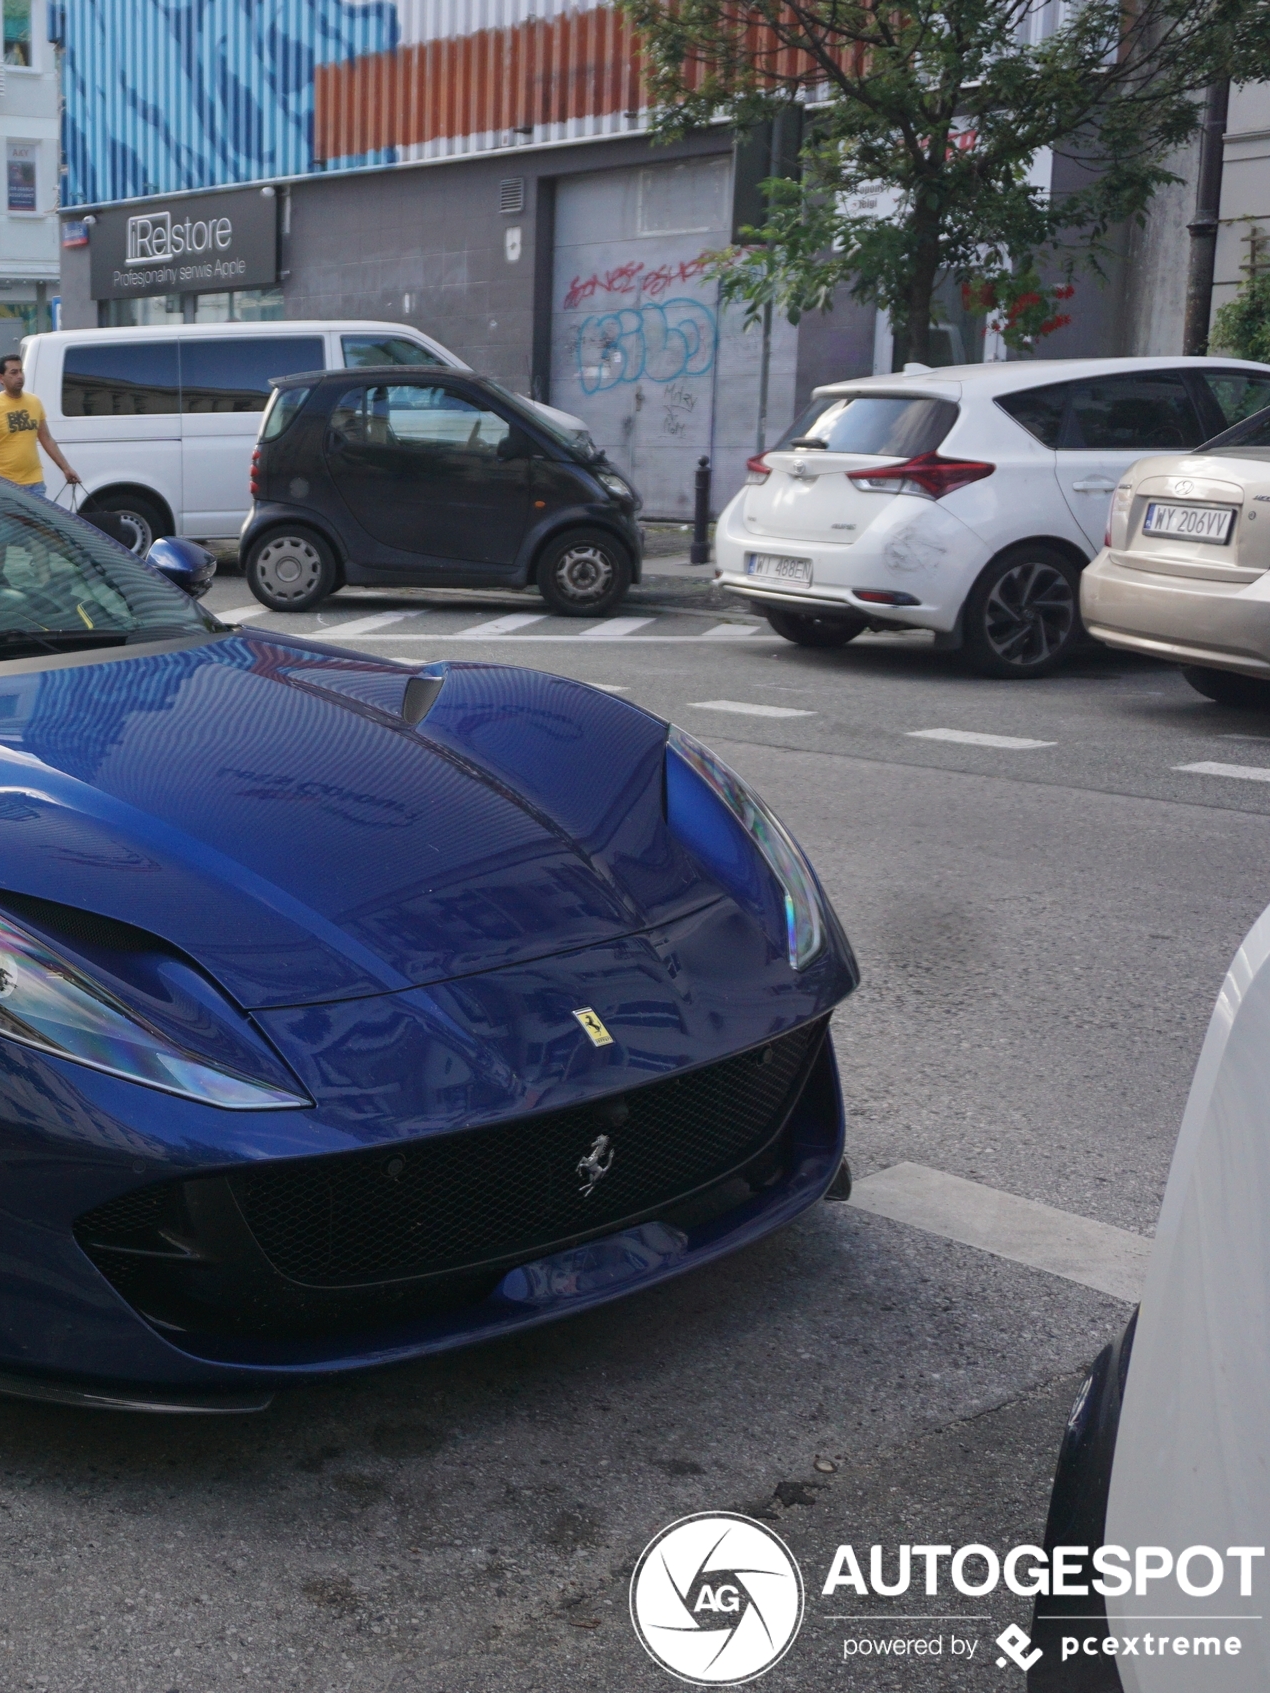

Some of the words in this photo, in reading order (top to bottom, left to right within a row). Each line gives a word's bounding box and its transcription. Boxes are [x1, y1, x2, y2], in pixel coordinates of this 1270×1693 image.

[12, 149, 29, 157] AKY
[113, 266, 176, 287] Profesjonalny
[179, 260, 212, 280] serwis
[214, 257, 246, 278] Apple
[6, 409, 30, 422] BIG
[9, 419, 38, 433] STAR
[1154, 507, 1176, 531] WY
[1177, 510, 1228, 537] 206VV
[756, 553, 770, 575] WI
[775, 558, 811, 580] 488EN
